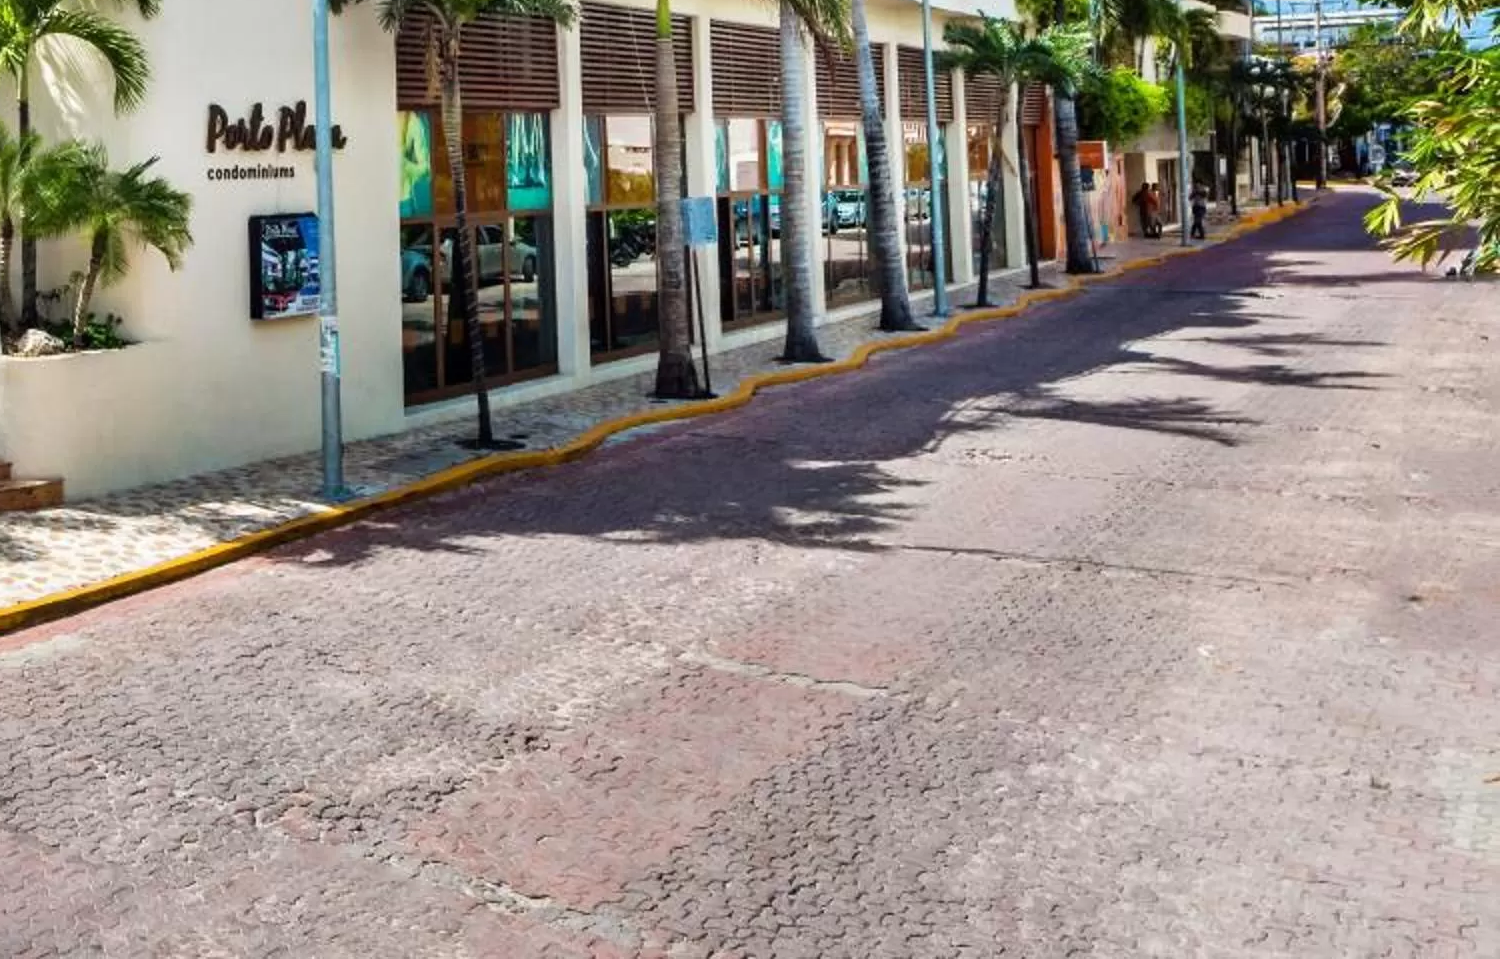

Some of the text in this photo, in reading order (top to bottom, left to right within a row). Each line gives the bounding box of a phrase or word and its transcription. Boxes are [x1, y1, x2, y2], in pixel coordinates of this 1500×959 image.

[207, 101, 347, 153] Porto Plaa
[207, 163, 295, 181] condominiums
